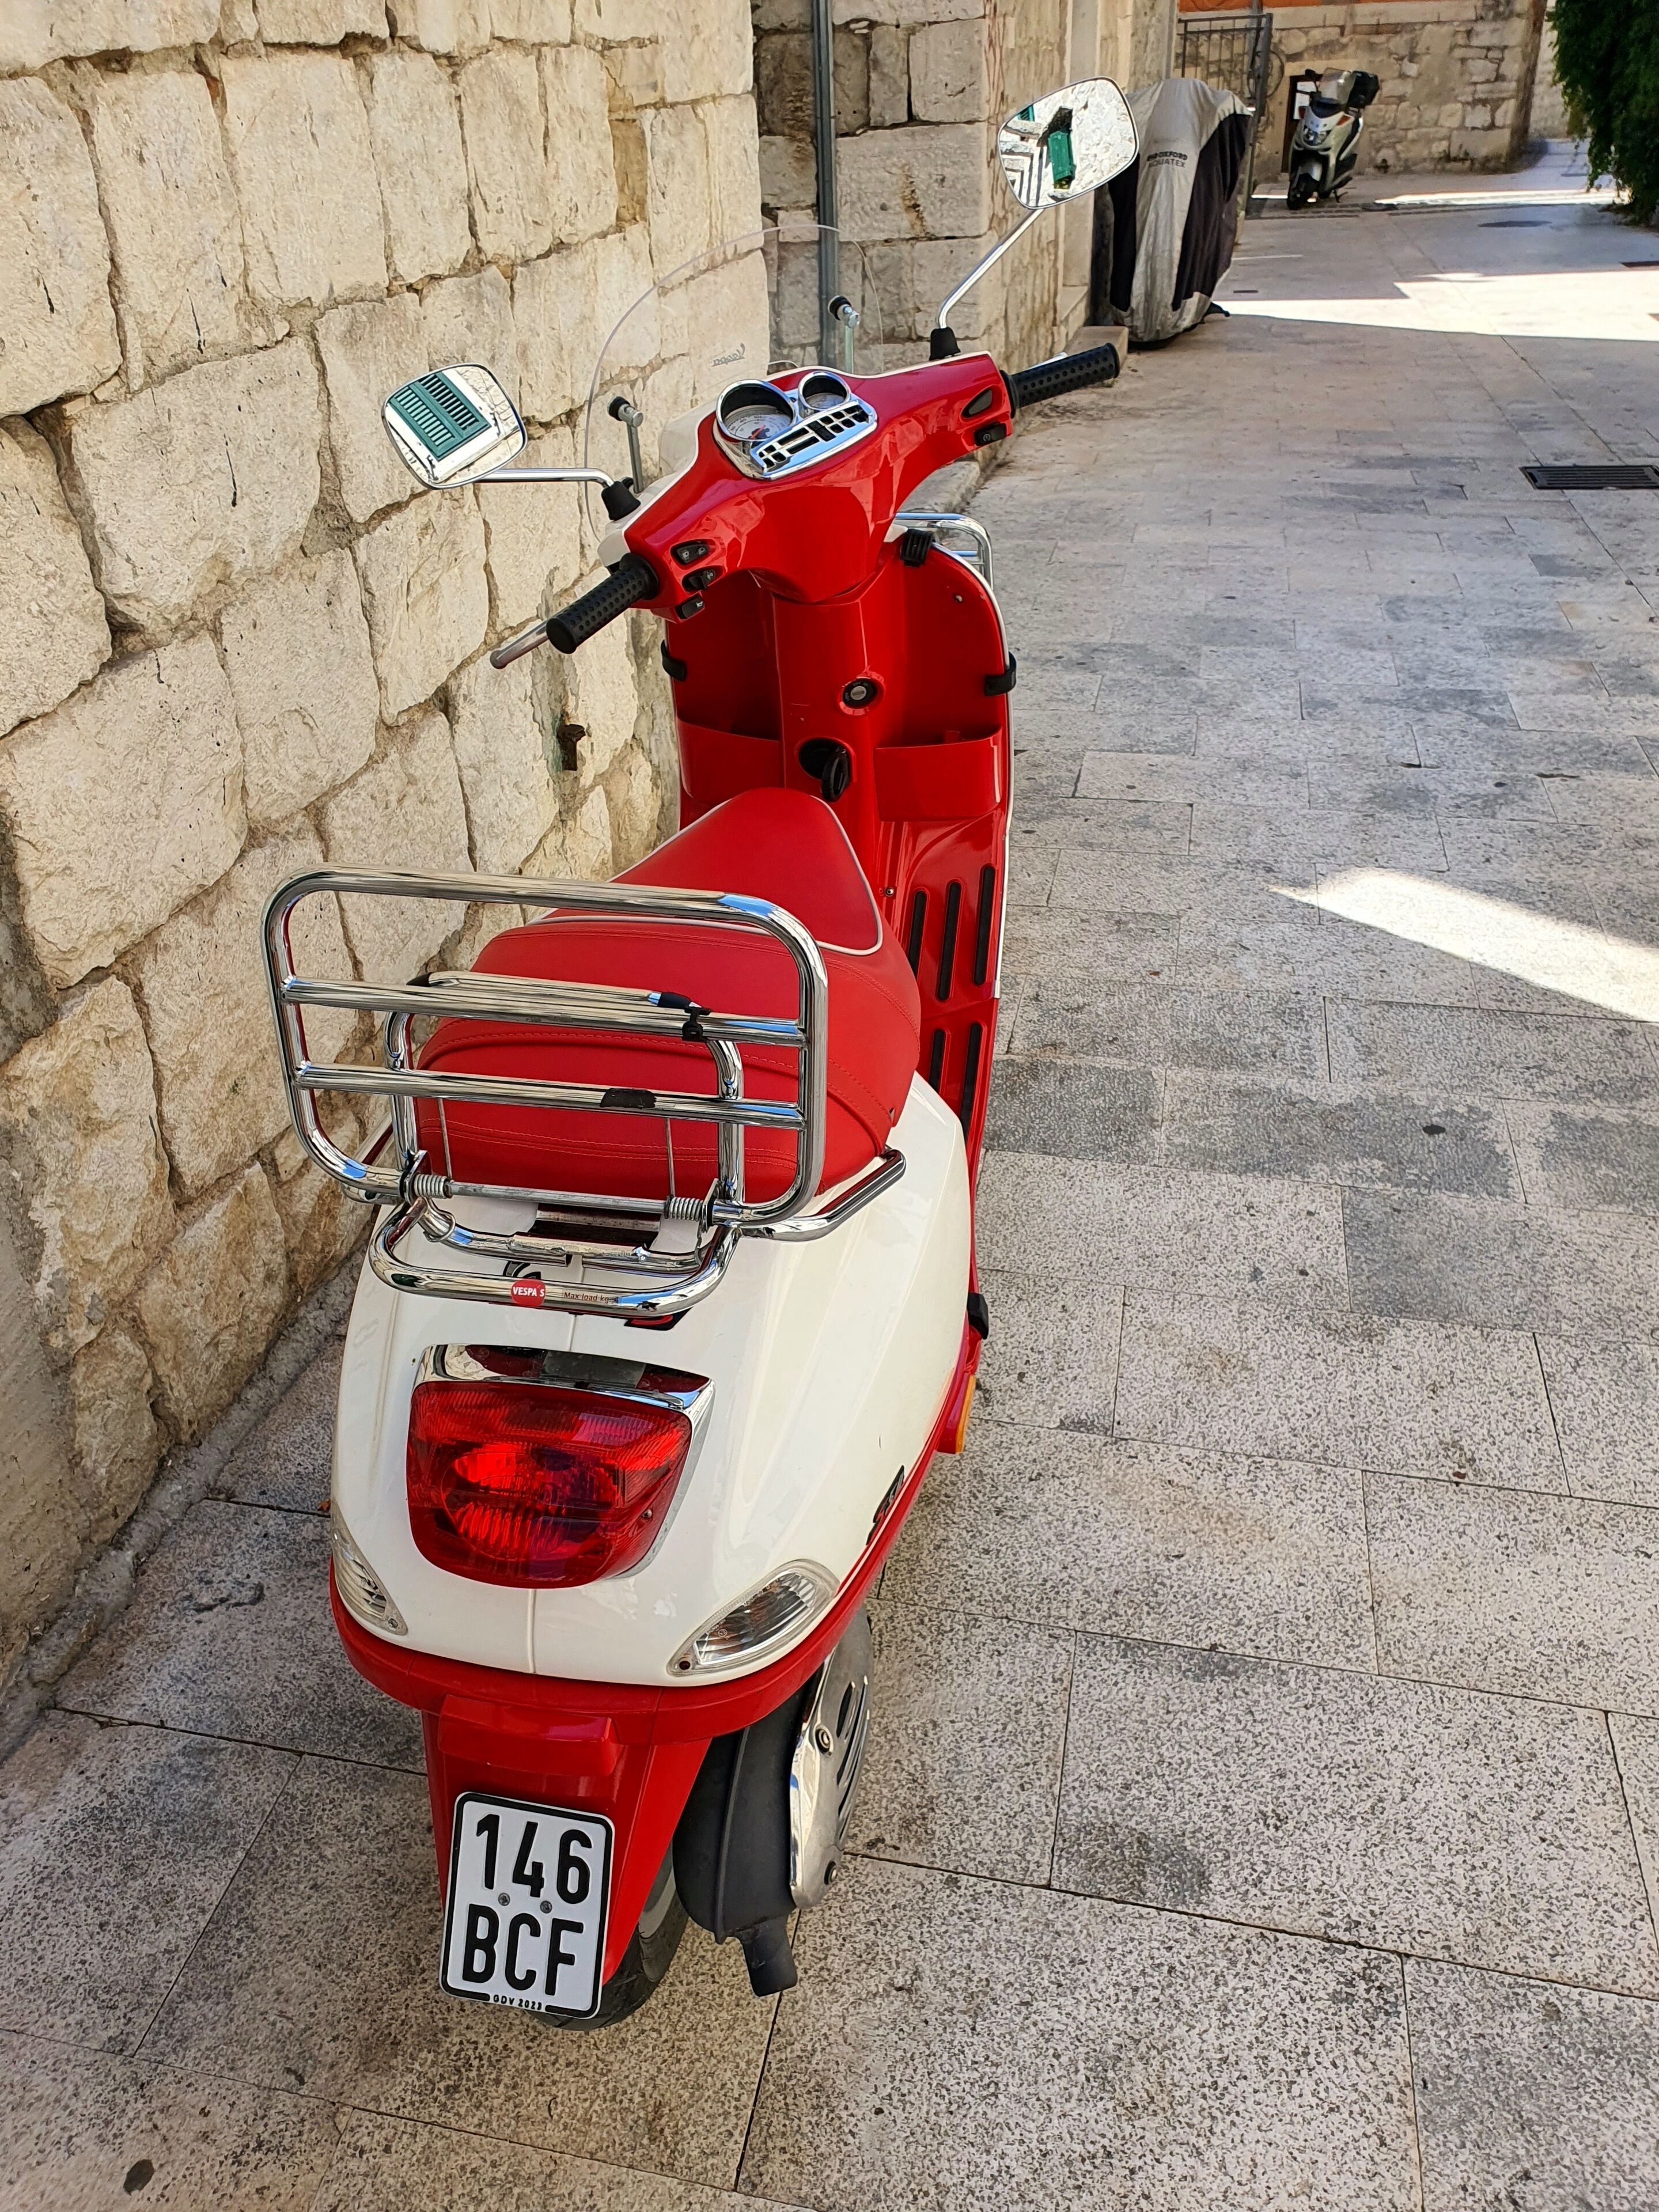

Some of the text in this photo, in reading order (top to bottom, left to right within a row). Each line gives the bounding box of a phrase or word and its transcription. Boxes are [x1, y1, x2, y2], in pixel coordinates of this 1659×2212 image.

[513, 1286, 545, 1297] VESPA S
[564, 1291, 580, 1300] Max
[582, 1293, 598, 1301] load
[476, 1813, 593, 1904] 146
[462, 1903, 584, 1996] BCF
[493, 1994, 542, 2010] GDV 2023
